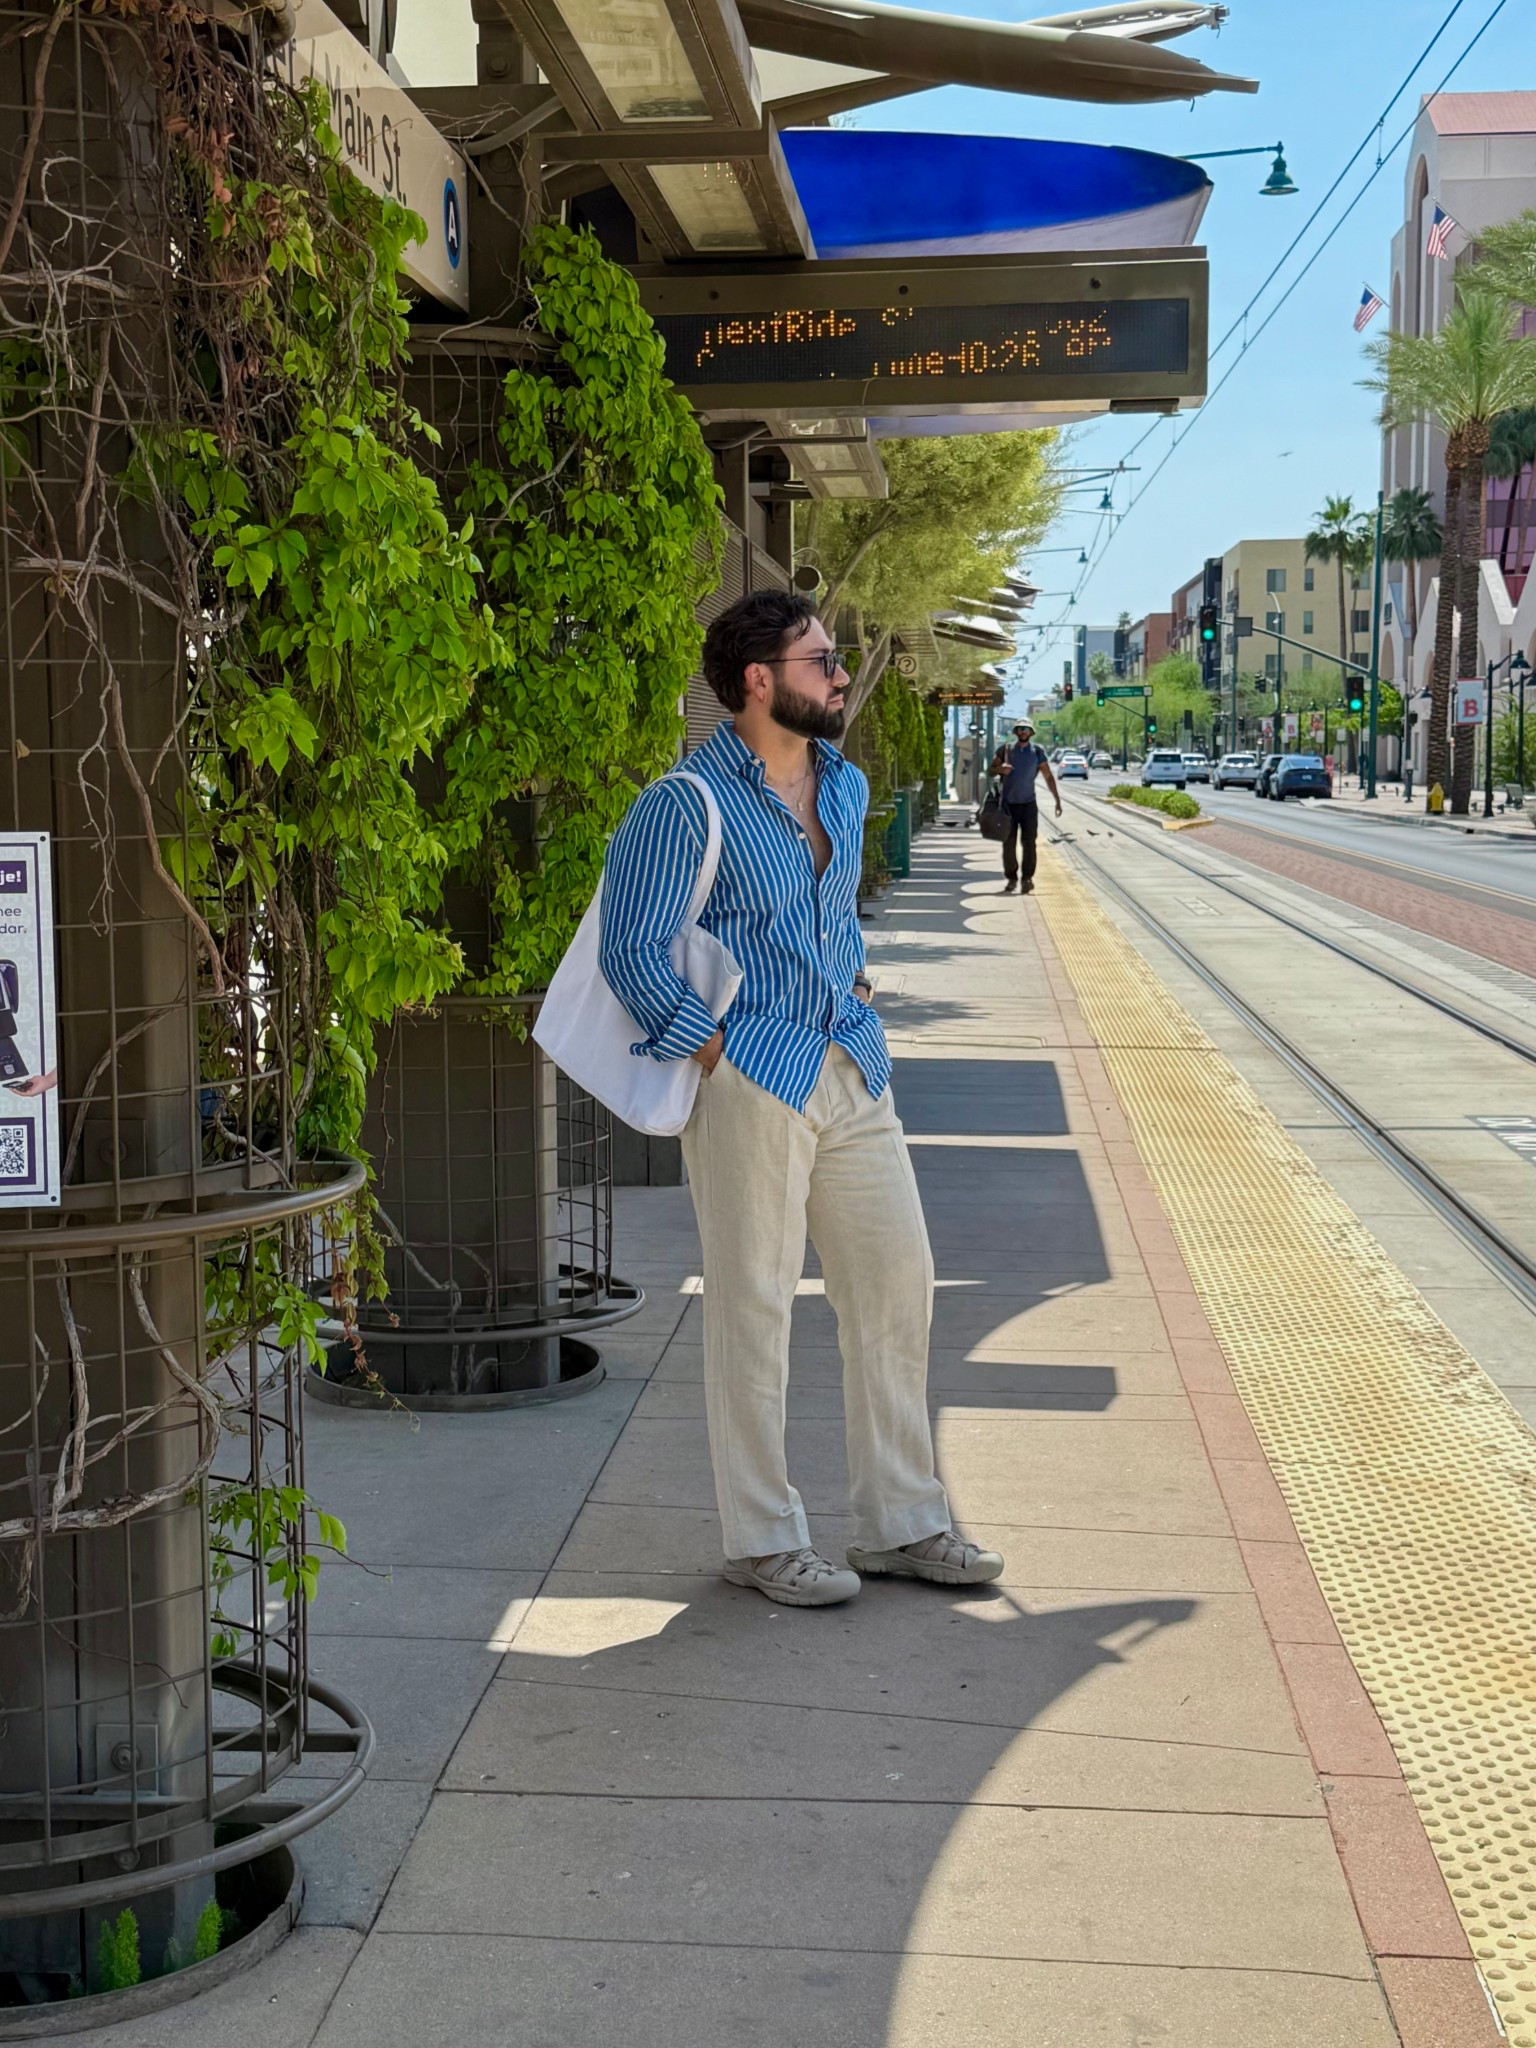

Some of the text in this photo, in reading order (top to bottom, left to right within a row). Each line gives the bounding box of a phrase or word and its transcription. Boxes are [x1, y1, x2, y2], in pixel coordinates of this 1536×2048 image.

[325, 51, 376, 178] Main
[381, 113, 407, 207] St.
[447, 200, 458, 249] A
[1463, 698, 1479, 718] B
